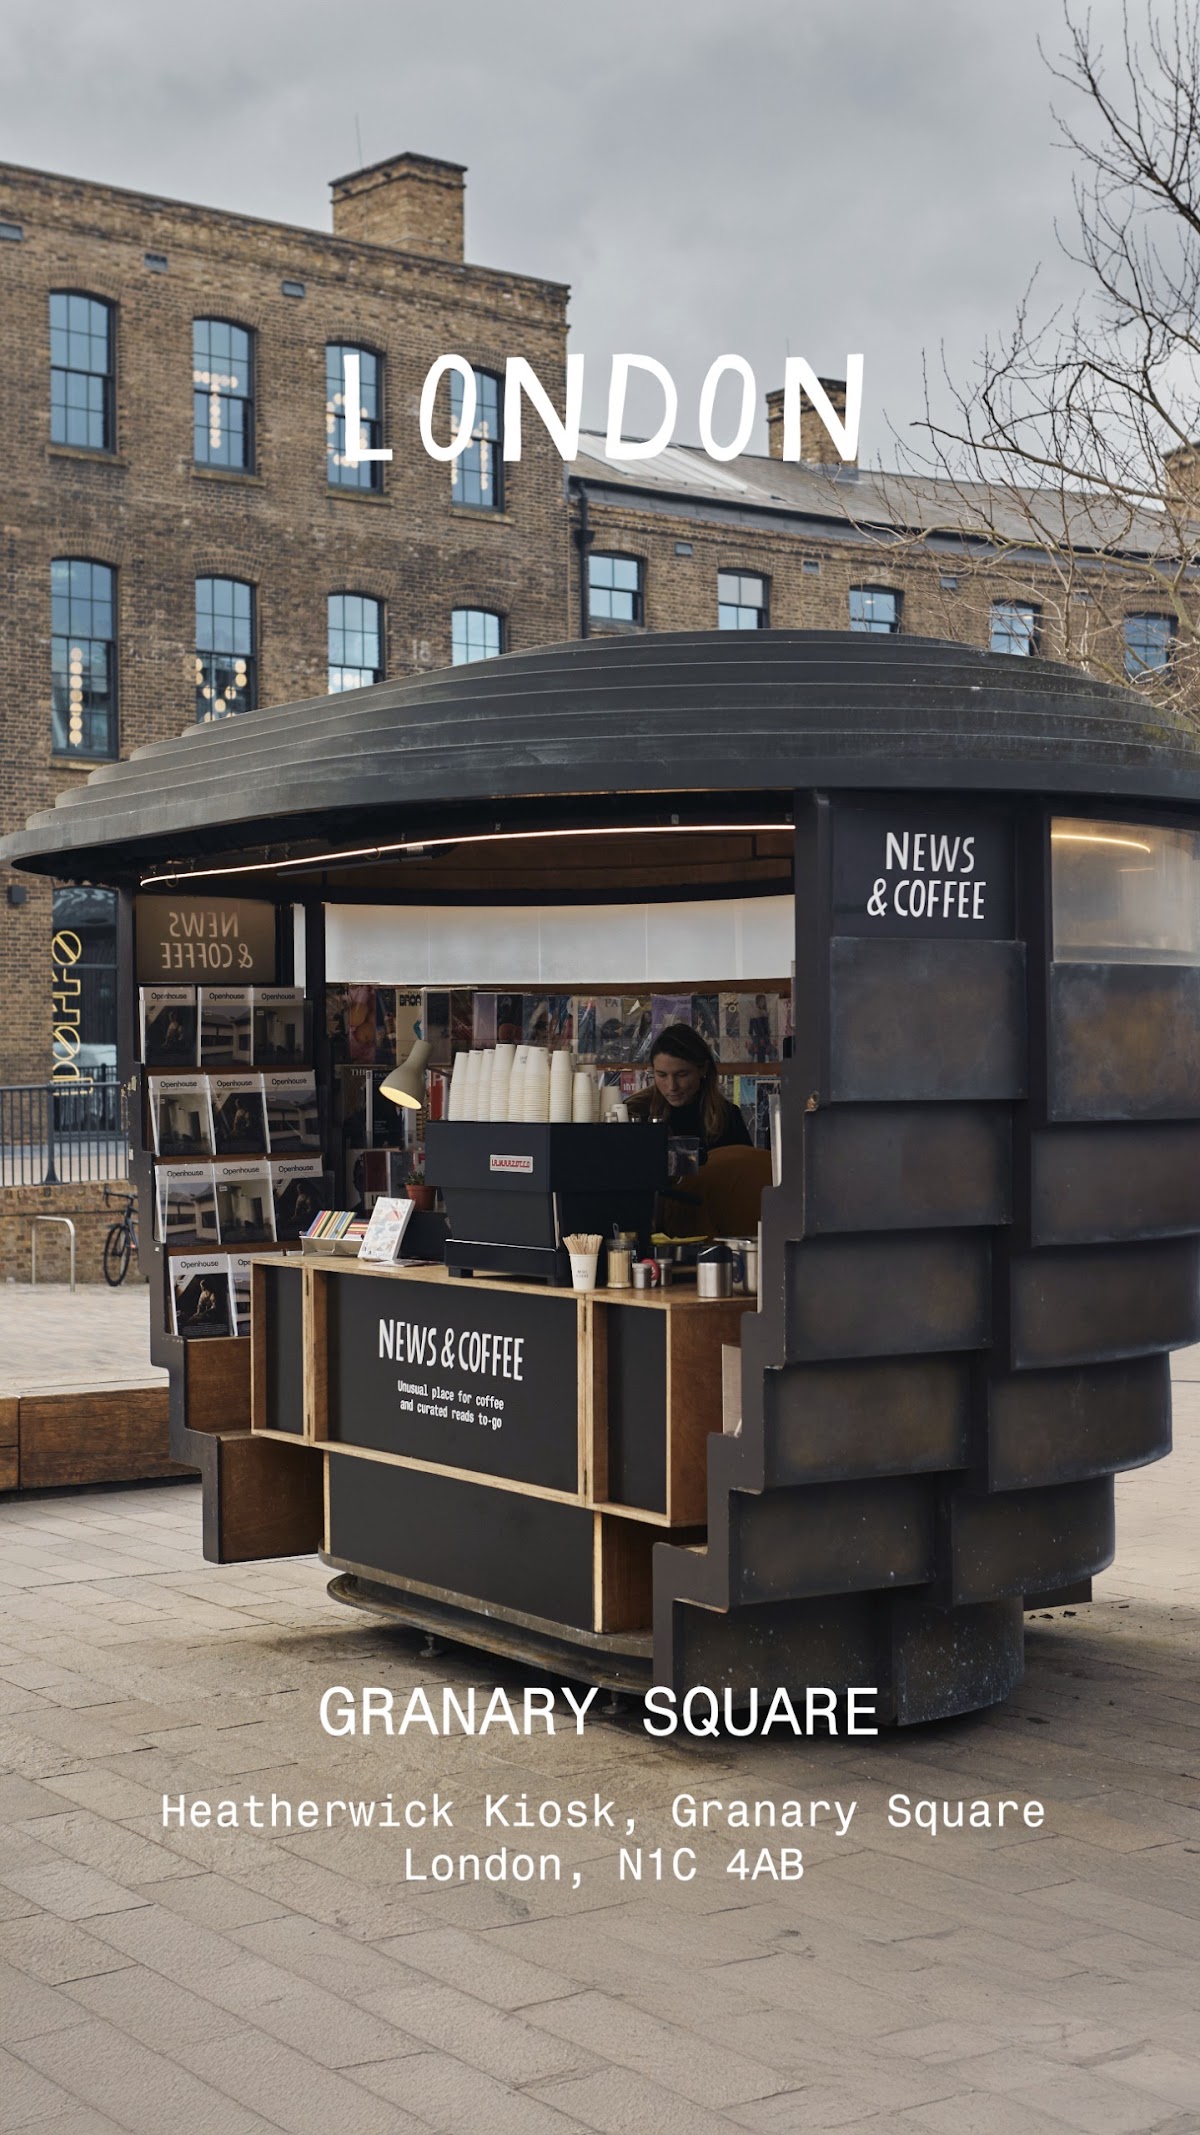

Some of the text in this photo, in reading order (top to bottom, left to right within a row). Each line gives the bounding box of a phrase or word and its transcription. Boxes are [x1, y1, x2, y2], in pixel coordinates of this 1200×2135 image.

[885, 832, 975, 873] NEWS
[894, 880, 987, 919] COFFEE
[151, 992, 187, 1000] Openhouse
[209, 992, 245, 1001] Openhouse
[261, 992, 296, 1001] Openhouse
[160, 1080, 198, 1089] Openhouse
[216, 1080, 253, 1088] Openhouse
[271, 1078, 307, 1087] Openhouse
[223, 1167, 260, 1175] Openhouse
[278, 1165, 314, 1173] Openhouse
[167, 1170, 204, 1179] Openhouse
[180, 1260, 219, 1269] Openhouse
[379, 1319, 437, 1367] NEWS
[458, 1331, 524, 1381] COFFEE
[397, 1380, 504, 1410] Unusual place for coffee
[400, 1399, 502, 1430] and curated reads to-go
